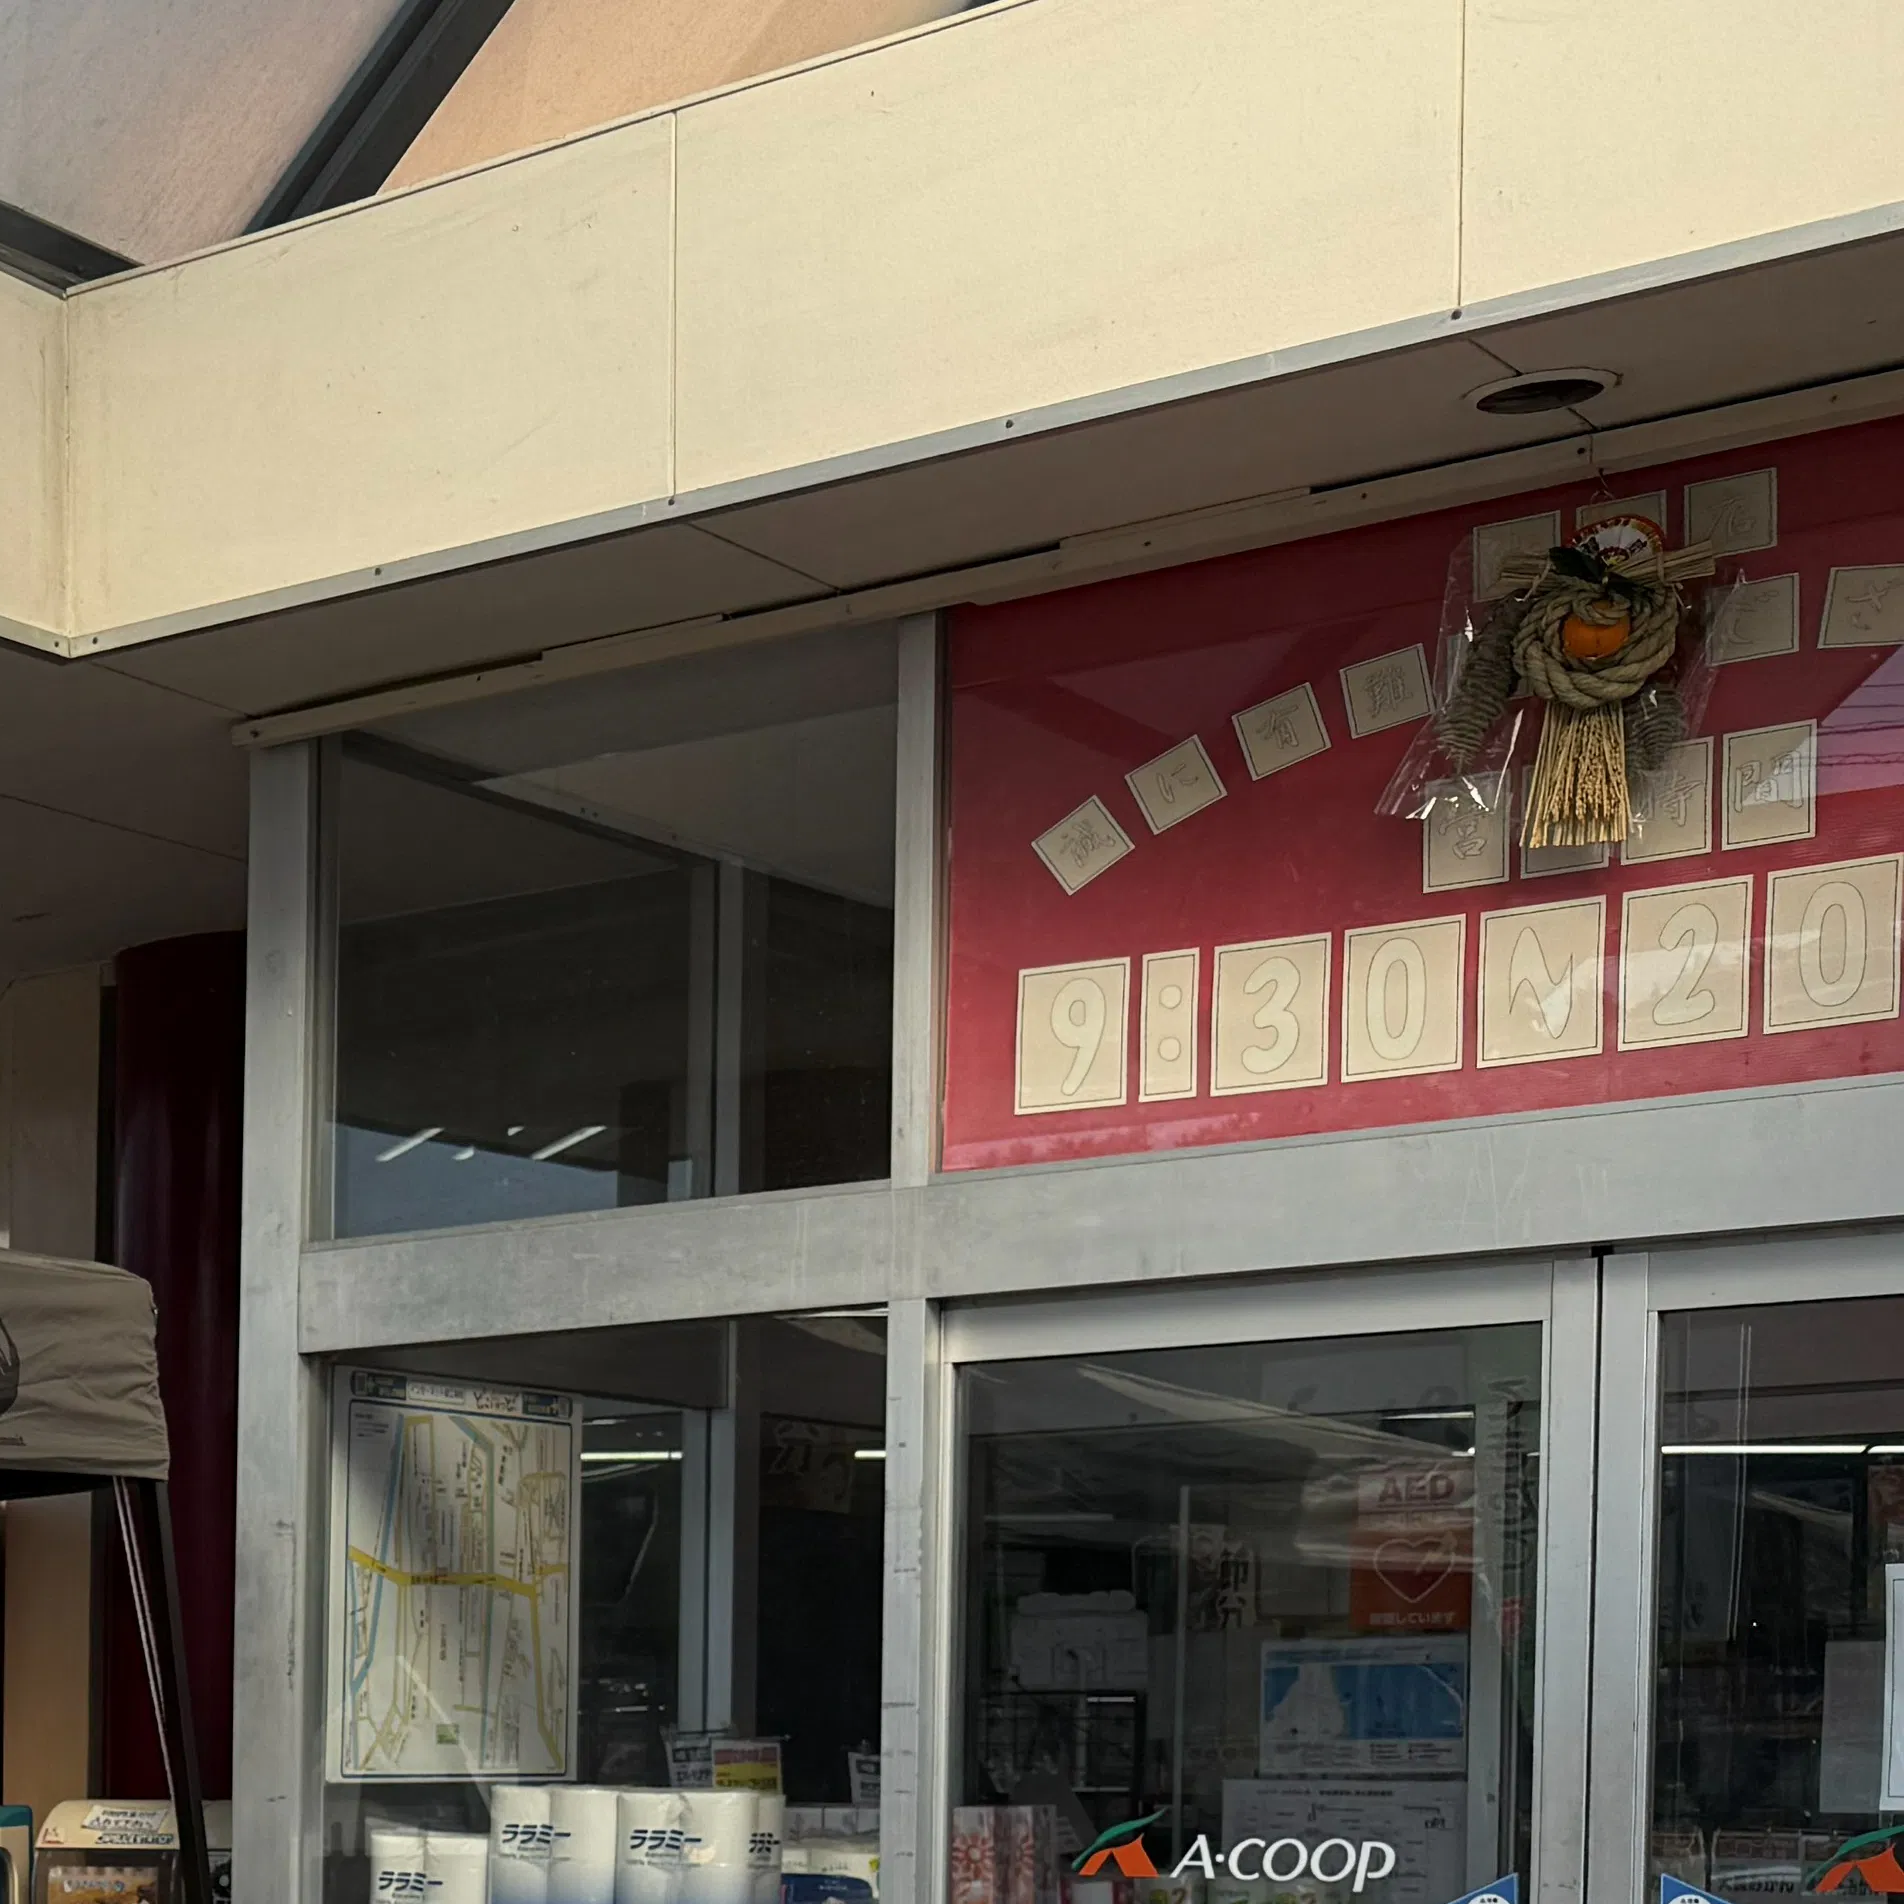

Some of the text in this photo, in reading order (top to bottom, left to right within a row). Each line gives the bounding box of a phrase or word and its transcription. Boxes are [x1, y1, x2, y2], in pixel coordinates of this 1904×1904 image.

[1378, 1472, 1455, 1502] AED
[502, 1823, 571, 1845] ララミー
[630, 1829, 702, 1850] ララミー
[378, 1870, 443, 1891] ララミー
